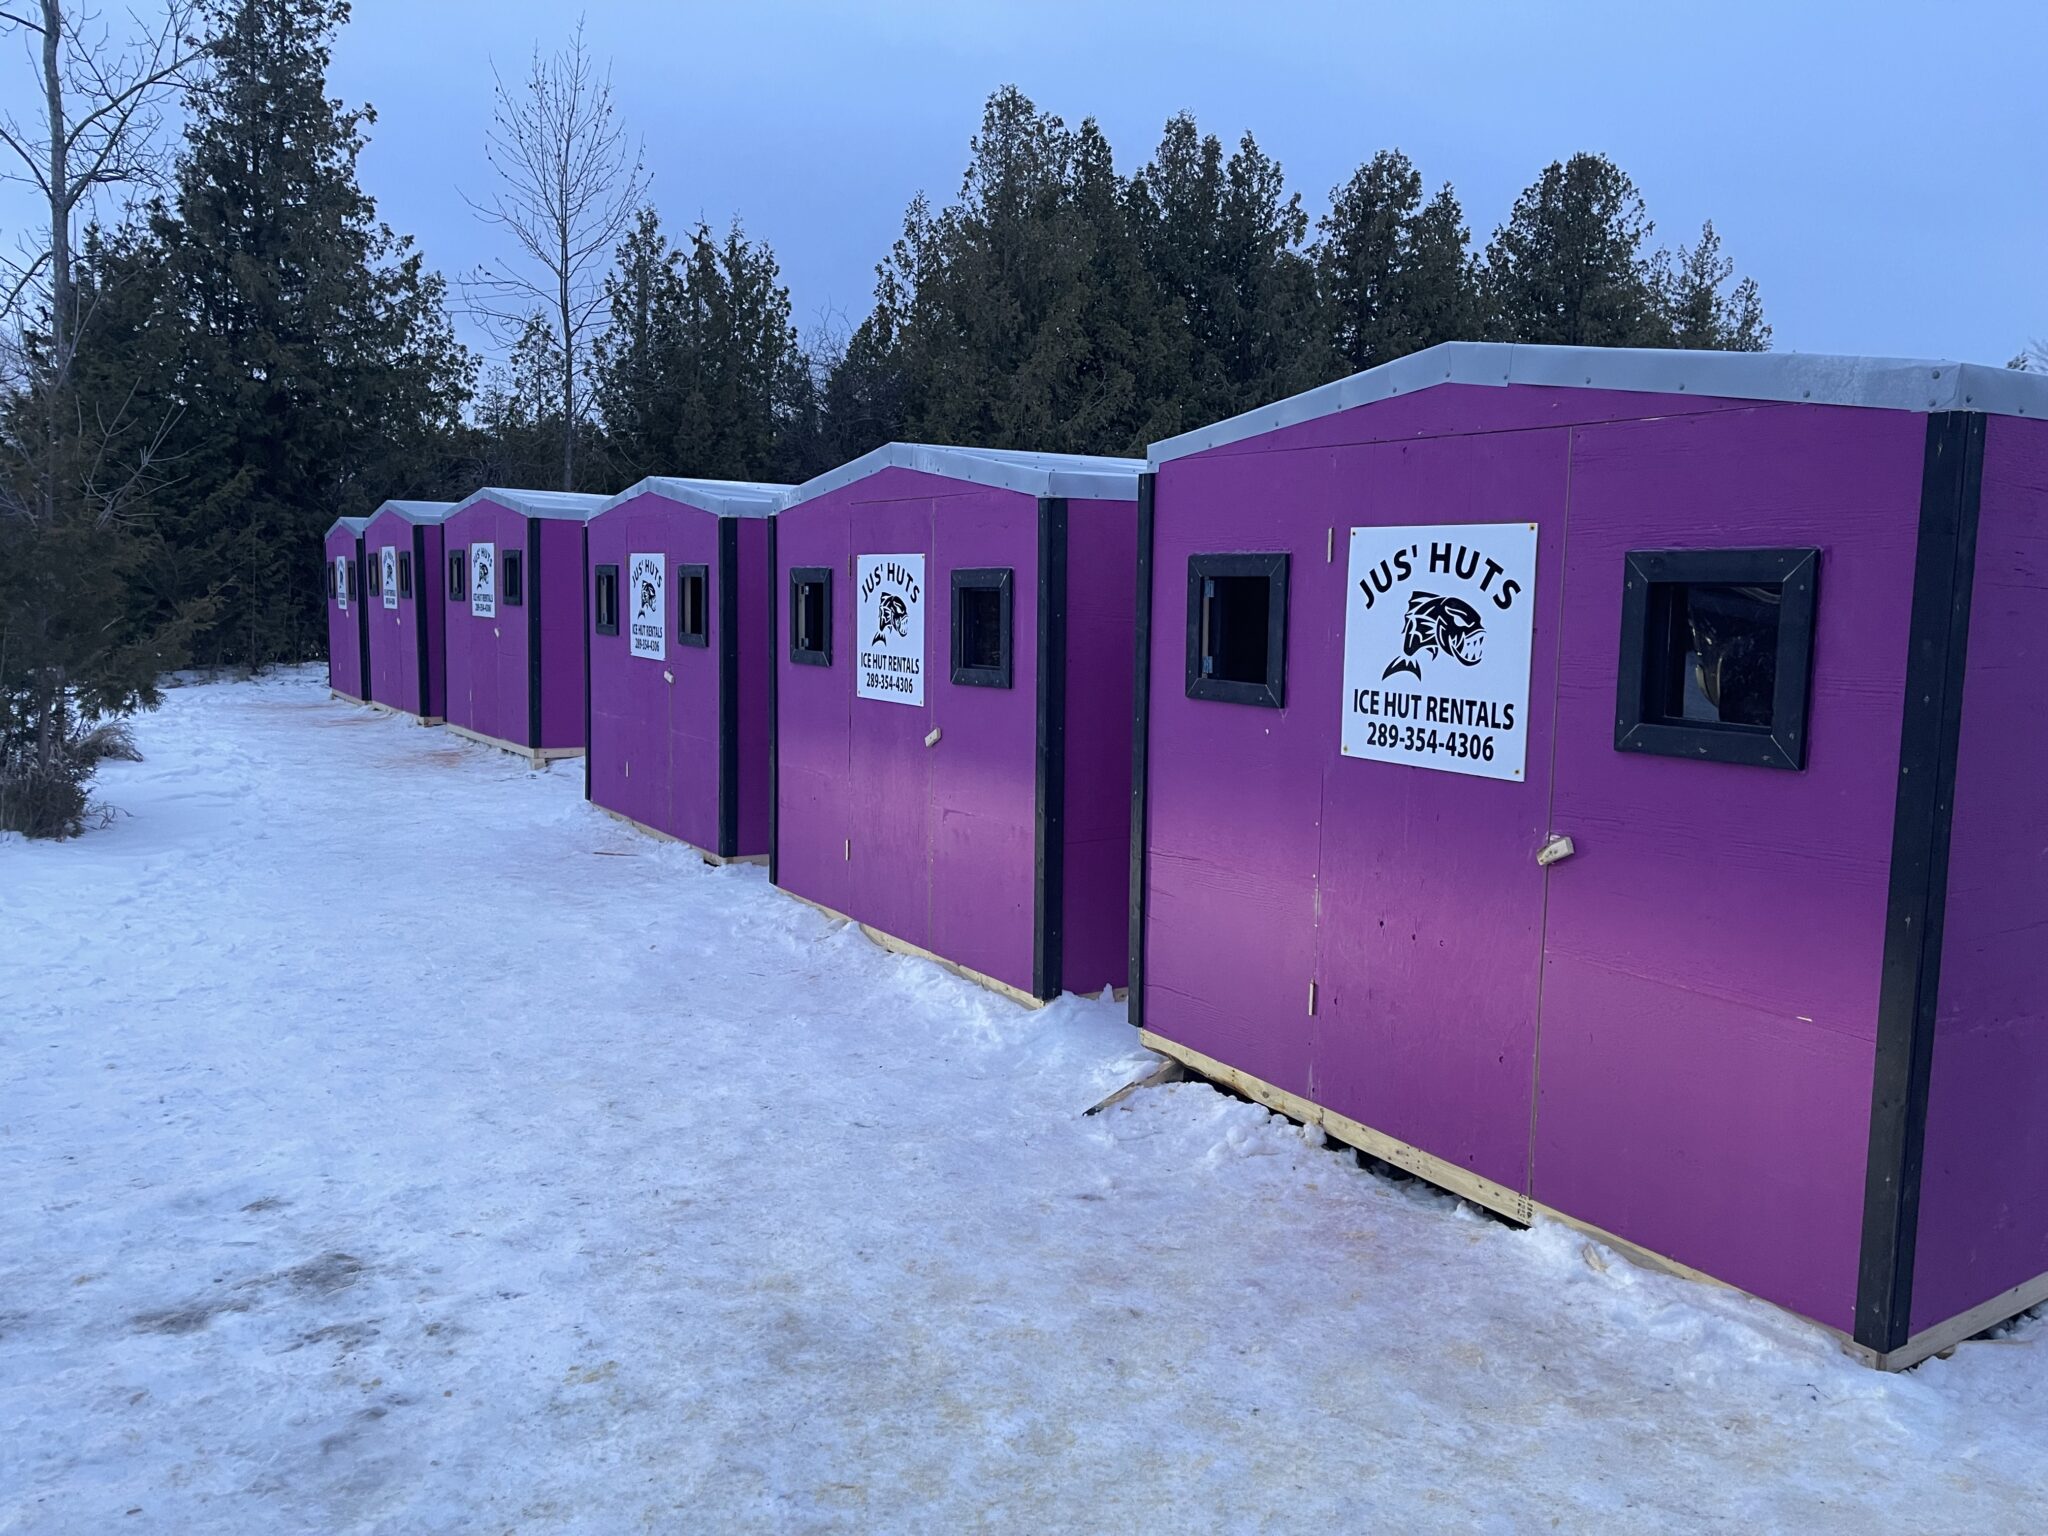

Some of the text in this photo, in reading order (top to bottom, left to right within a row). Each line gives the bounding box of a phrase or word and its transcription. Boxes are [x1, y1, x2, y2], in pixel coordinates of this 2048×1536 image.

[632, 559, 662, 588] JUS' HUTS
[861, 562, 920, 604] JUS' HUTS
[1359, 542, 1522, 610] JUS' HUTS
[646, 625, 662, 638] RENTALS
[860, 652, 920, 674] ICE HUT RENTALS
[866, 672, 913, 694] 289-354-4306
[1354, 688, 1514, 730] ICE HUT RENTALS
[1366, 722, 1494, 762] 289-354-4306
